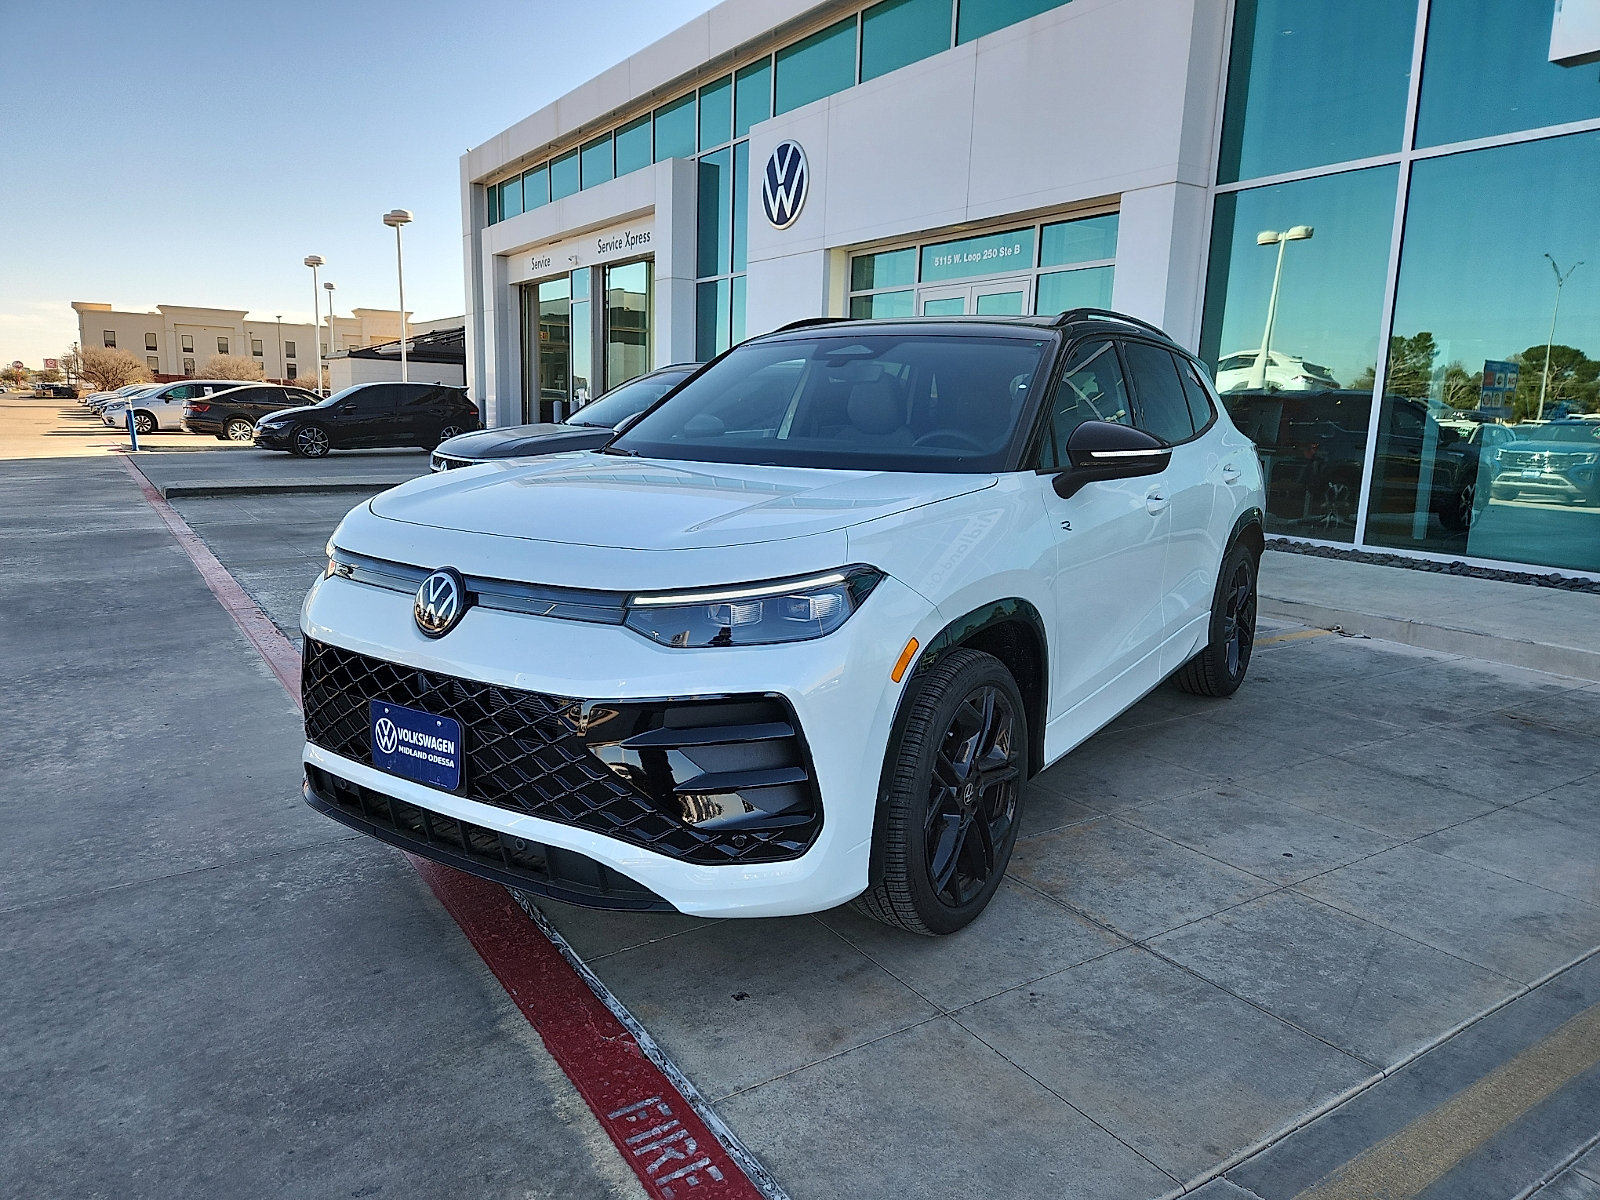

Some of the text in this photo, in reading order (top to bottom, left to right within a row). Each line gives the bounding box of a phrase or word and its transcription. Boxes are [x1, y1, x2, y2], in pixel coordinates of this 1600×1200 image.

[597, 231, 651, 254] Service Xpress
[531, 255, 551, 270] Service
[934, 255, 952, 266] 5115
[963, 252, 981, 263] Loop
[982, 248, 998, 260] 250
[999, 246, 1012, 257] Ste
[1014, 244, 1021, 255] B
[397, 727, 455, 754] VOLKSWAGEN
[398, 745, 455, 768] MIDLAND ODESSA
[608, 1096, 724, 1199] FIRE
